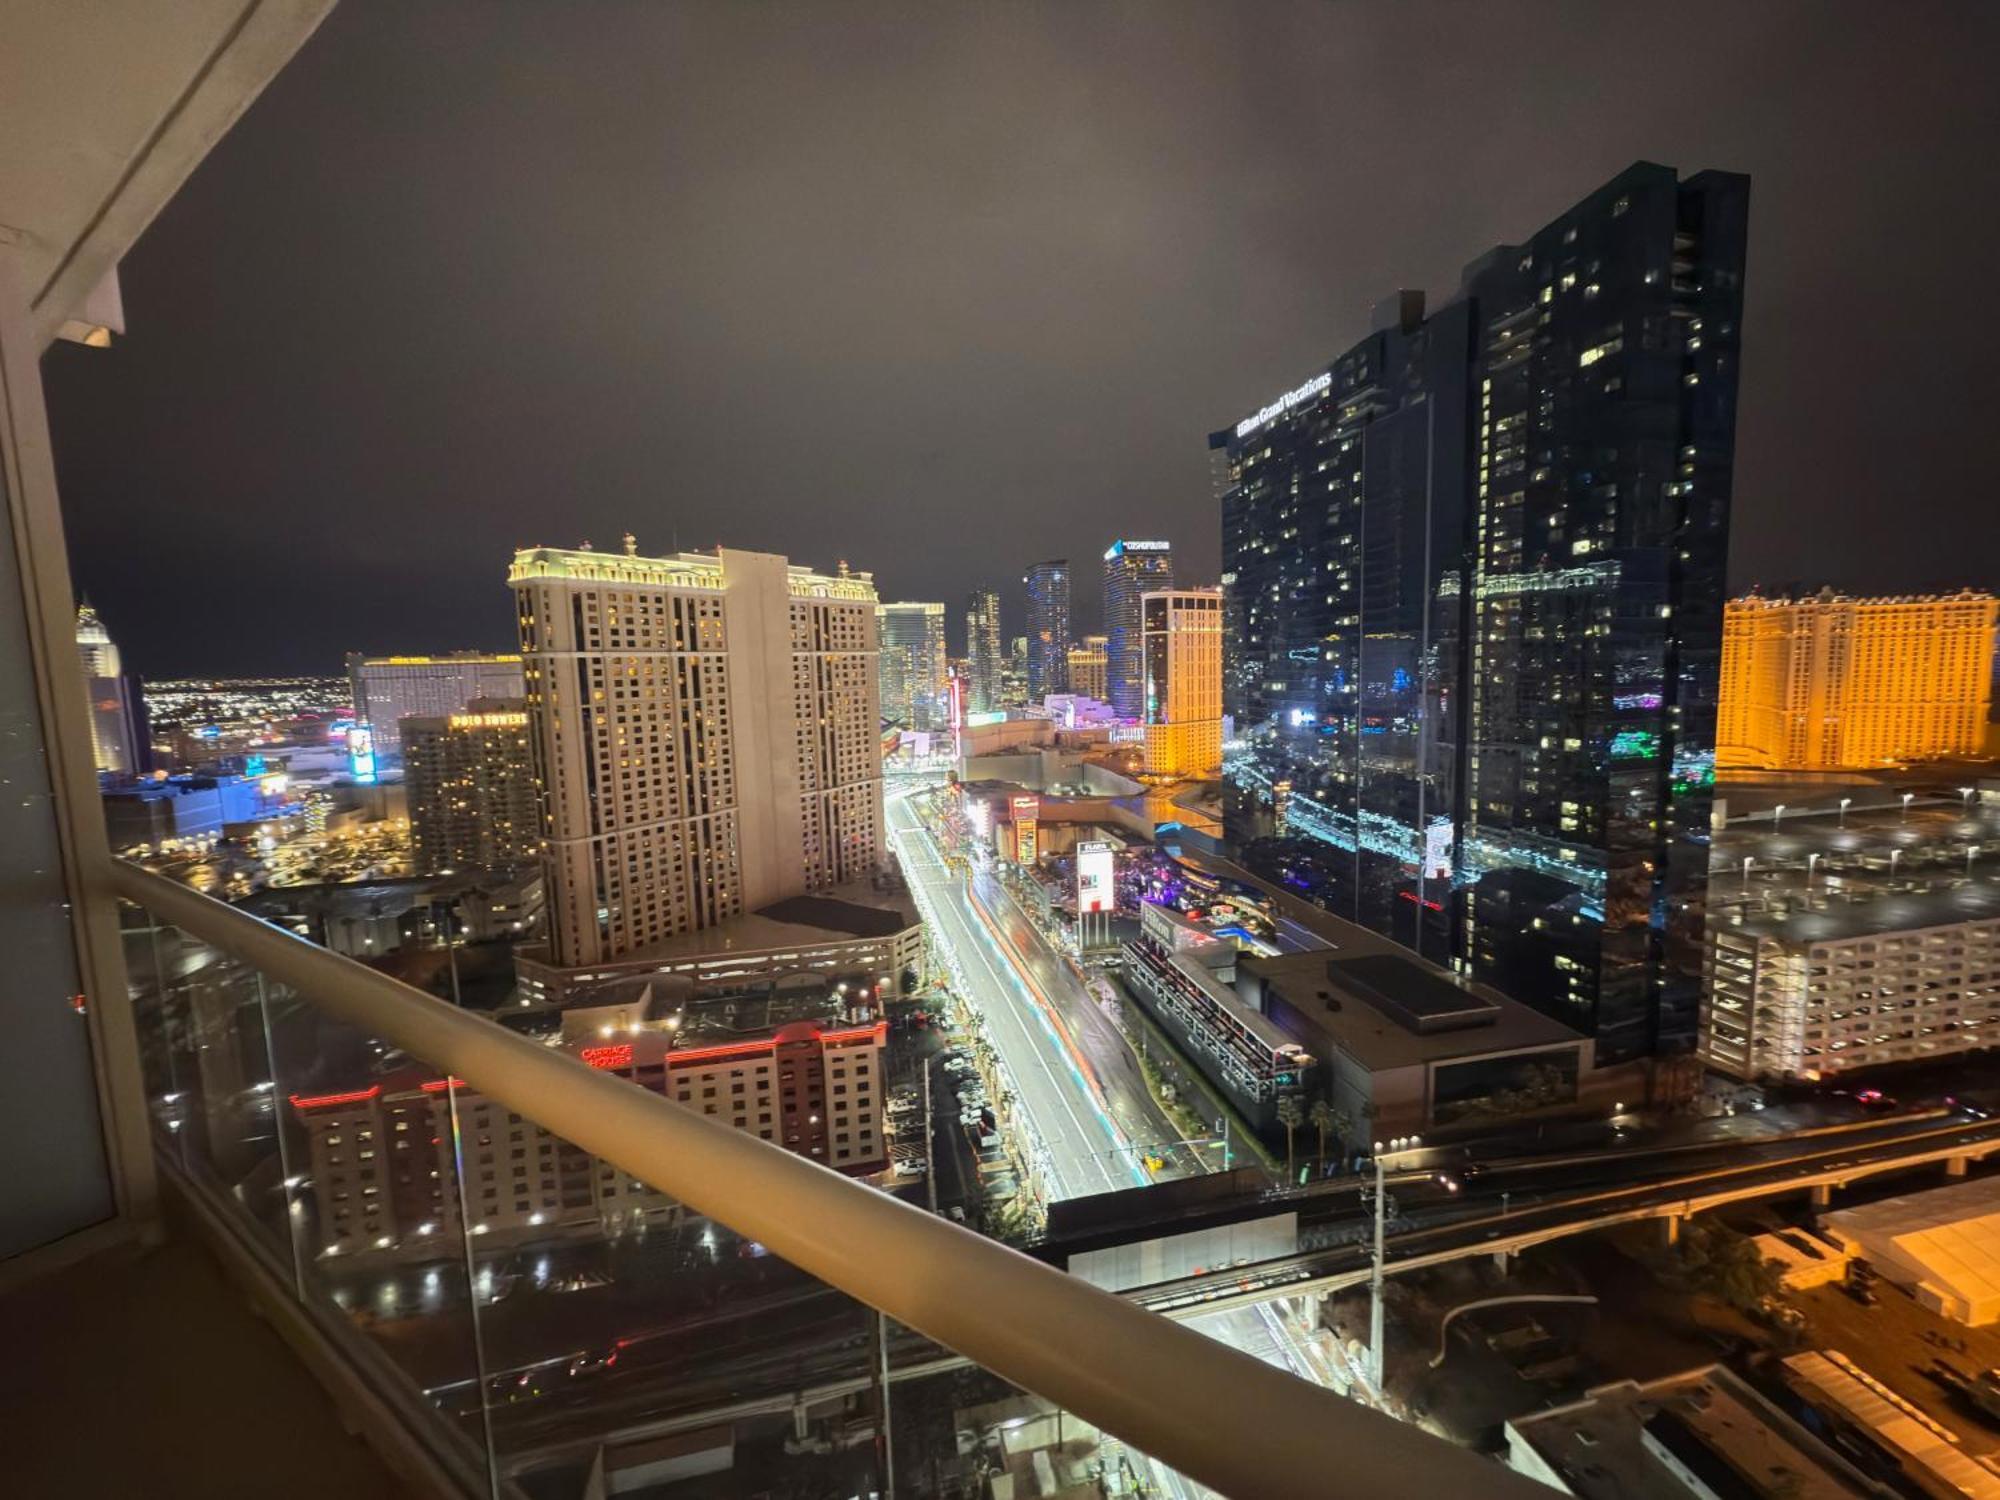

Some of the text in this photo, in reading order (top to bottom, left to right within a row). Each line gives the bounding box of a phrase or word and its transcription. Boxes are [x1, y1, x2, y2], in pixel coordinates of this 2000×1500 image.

[1260, 396, 1284, 423] Grand
[1283, 373, 1333, 408] Vacations
[582, 1045, 633, 1059] CARRIAGE
